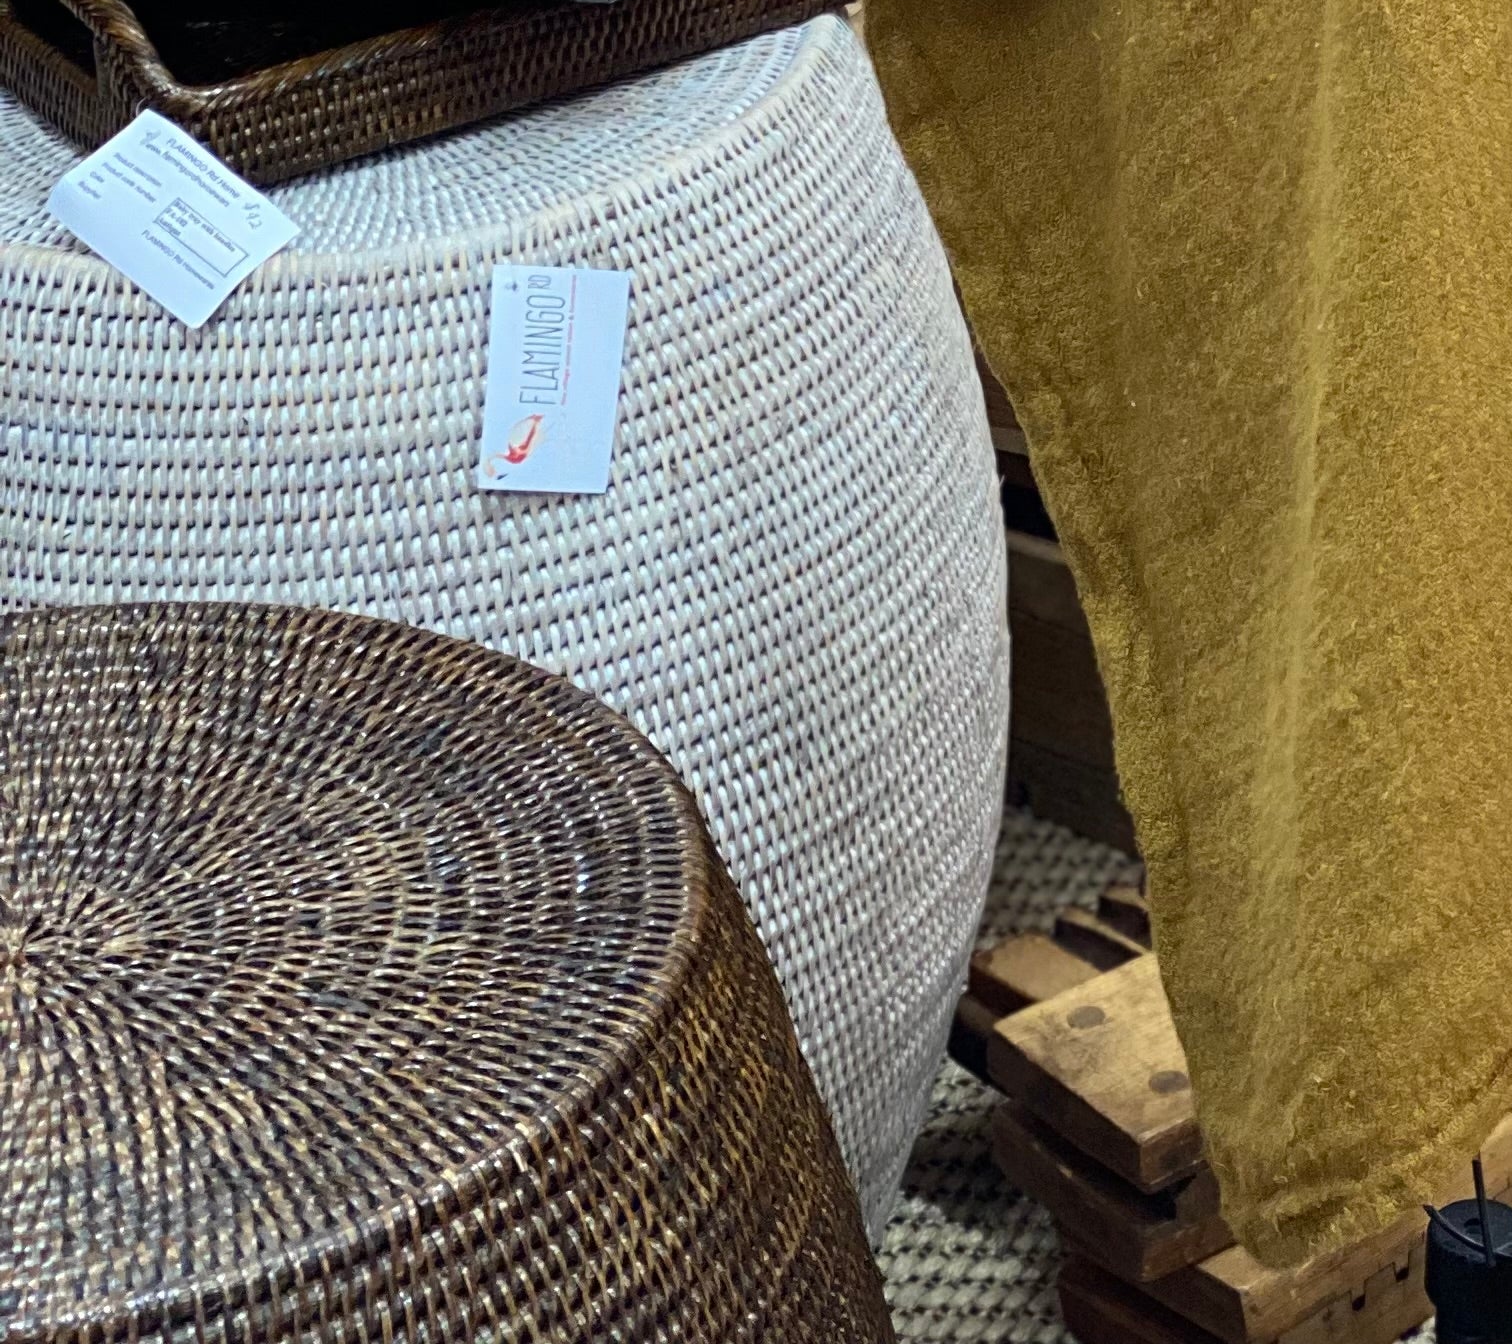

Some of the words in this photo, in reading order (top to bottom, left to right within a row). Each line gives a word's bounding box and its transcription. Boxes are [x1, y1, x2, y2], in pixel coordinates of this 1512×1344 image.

[166, 138, 209, 173] FLAMINGO
[205, 170, 220, 187] Rd
[141, 229, 175, 258] FLAMINGO
[527, 274, 552, 290] RD
[519, 295, 566, 405] FLAMINGO
